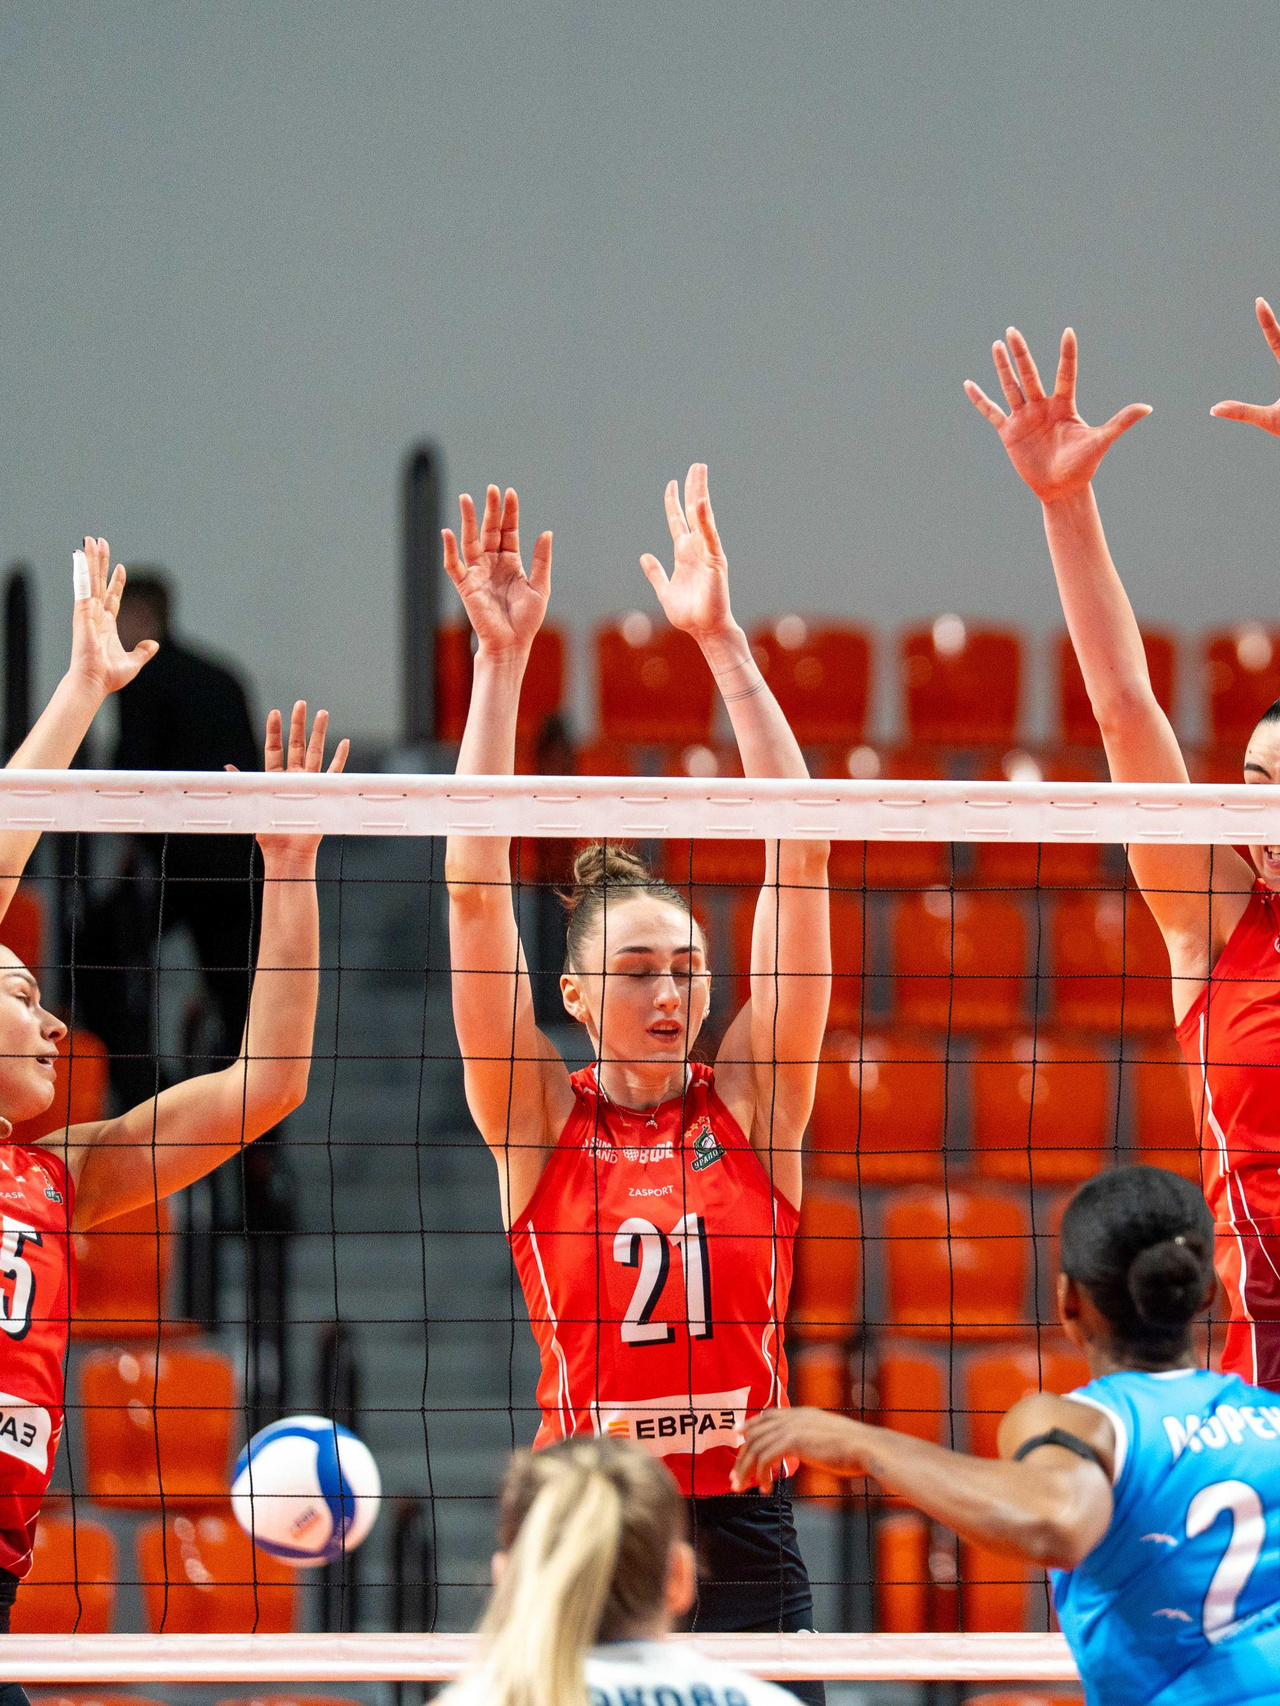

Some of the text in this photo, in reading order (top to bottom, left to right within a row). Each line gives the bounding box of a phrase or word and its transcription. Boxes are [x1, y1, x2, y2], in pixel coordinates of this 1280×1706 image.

[628, 1184, 675, 1198] ZASPORT
[613, 1211, 713, 1347] 21
[635, 1410, 737, 1441] ЕВРАЗ
